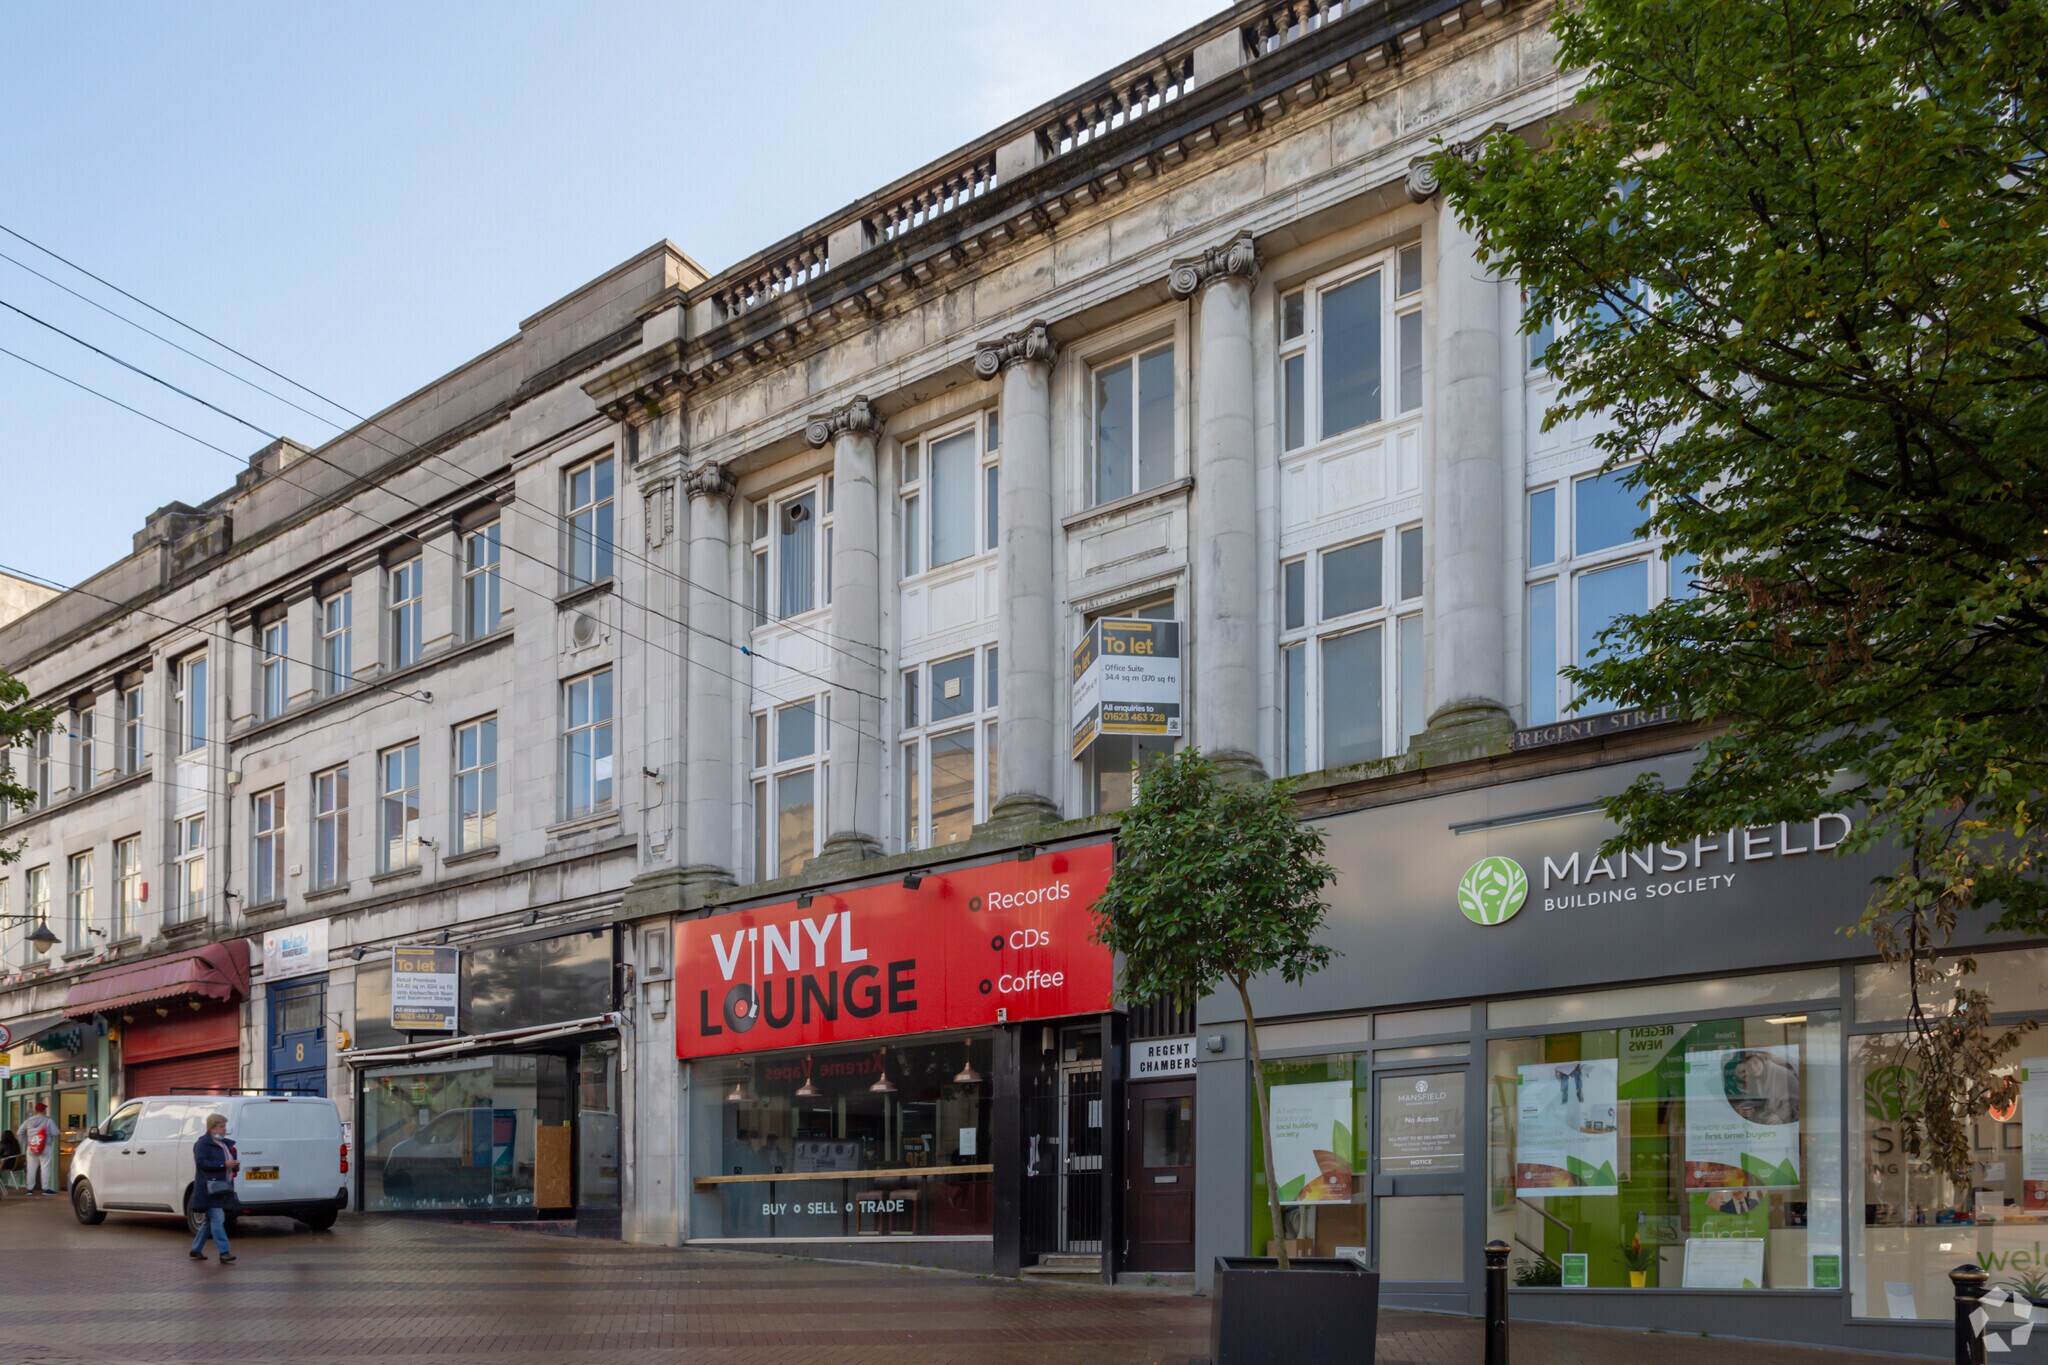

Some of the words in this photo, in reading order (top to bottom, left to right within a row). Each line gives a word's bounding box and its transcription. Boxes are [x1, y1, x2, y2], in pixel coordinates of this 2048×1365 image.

[1103, 636, 1126, 653] To
[1130, 637, 1153, 655] let
[1105, 664, 1126, 672] Office
[1105, 673, 1119, 681] 34.4
[1141, 674, 1155, 682] (370
[1167, 675, 1176, 683] ft)
[1114, 705, 1145, 713] enquiries
[1103, 712, 1129, 720] 01623
[1131, 713, 1147, 721] 463
[1150, 714, 1165, 722] 728
[1519, 719, 1595, 747] REGENT
[1610, 702, 1681, 729] STREE
[1543, 812, 1852, 890] MANSFIELD
[988, 880, 1070, 911] Records
[1544, 887, 1638, 912] BUILDING
[1645, 873, 1737, 899] SOCIETY
[711, 911, 868, 981] VINYL
[1009, 929, 1050, 950] CDs
[396, 960, 413, 971] To
[417, 960, 435, 972] let
[998, 969, 1064, 993] Coffee
[700, 959, 918, 1037] LOUNGE
[296, 1043, 304, 1062] 8
[1148, 1043, 1190, 1057] REGENT
[1140, 1058, 1197, 1072] CHAMBERS
[1398, 1092, 1446, 1102] MANSFIELD
[1292, 1121, 1318, 1131] building
[1705, 1132, 1722, 1140] first
[1746, 1130, 1777, 1140] buyers
[762, 1203, 787, 1215] BUY
[807, 1202, 837, 1214] SELL
[859, 1200, 905, 1214] TRADE
